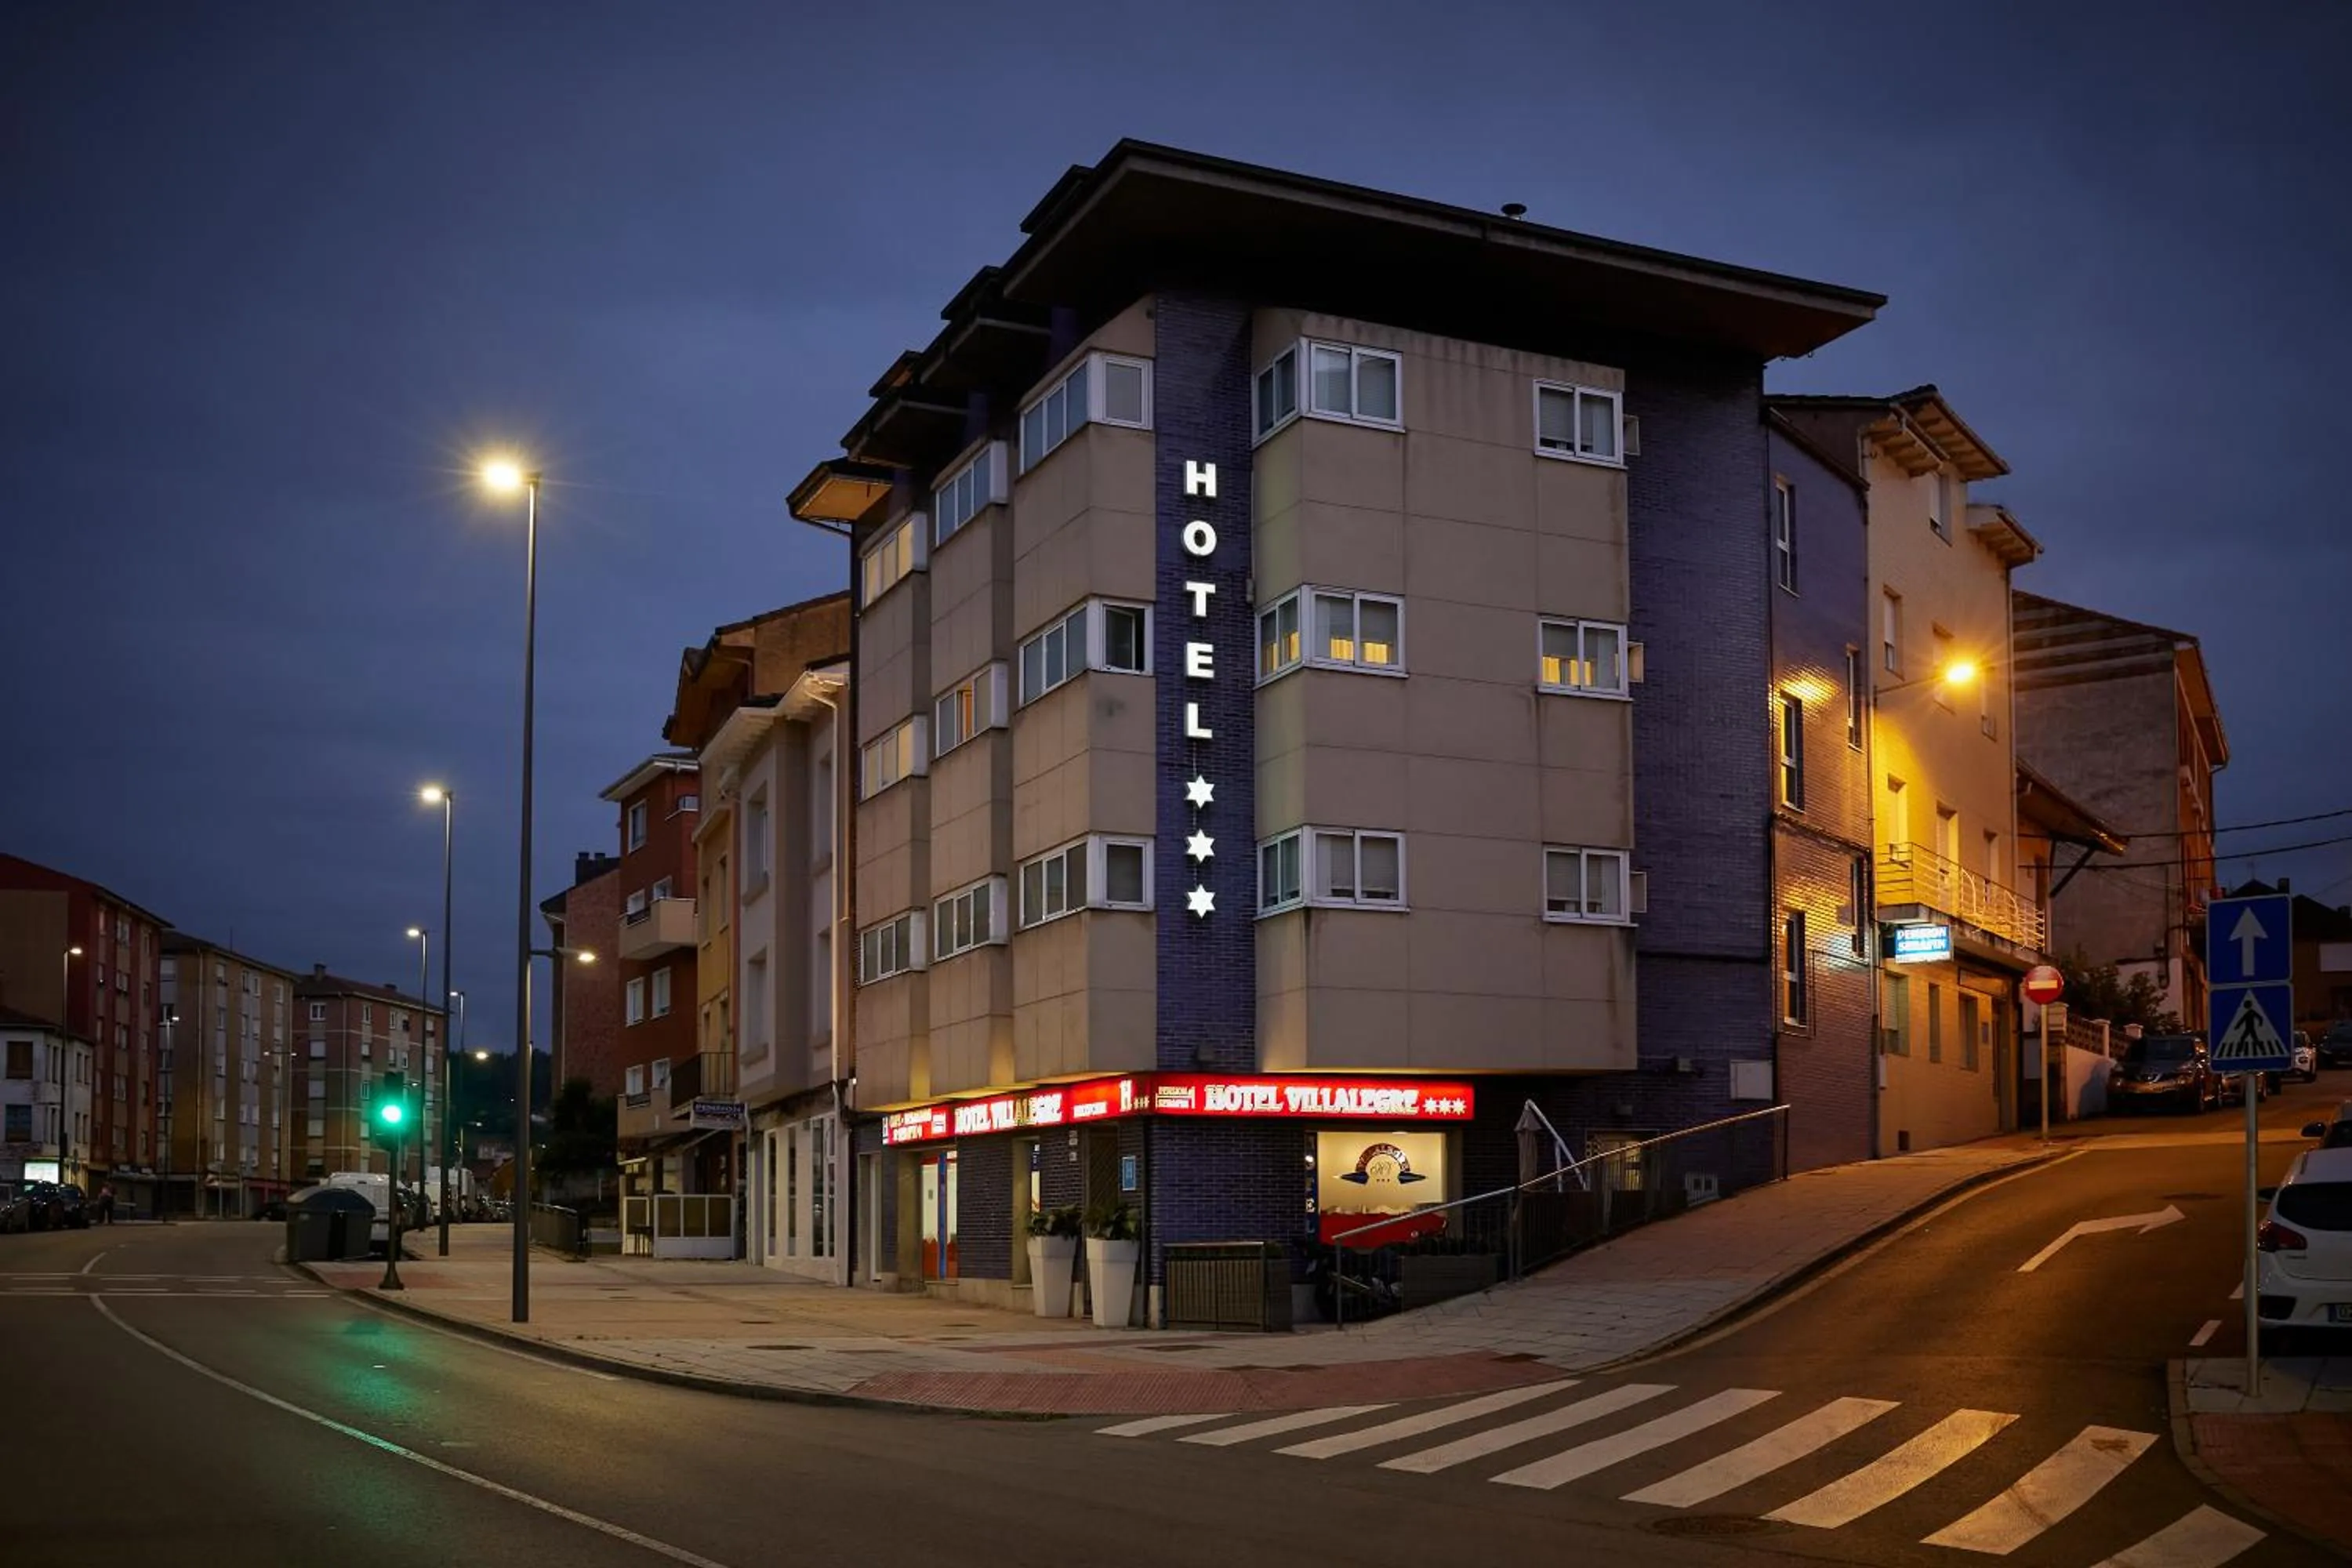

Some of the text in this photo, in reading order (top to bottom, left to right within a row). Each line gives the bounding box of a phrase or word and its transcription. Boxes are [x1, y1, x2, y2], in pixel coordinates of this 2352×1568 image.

[1181, 459, 1217, 739] HOTEL
[1203, 1084, 1420, 1114] HOTEL VILLALEGRE
